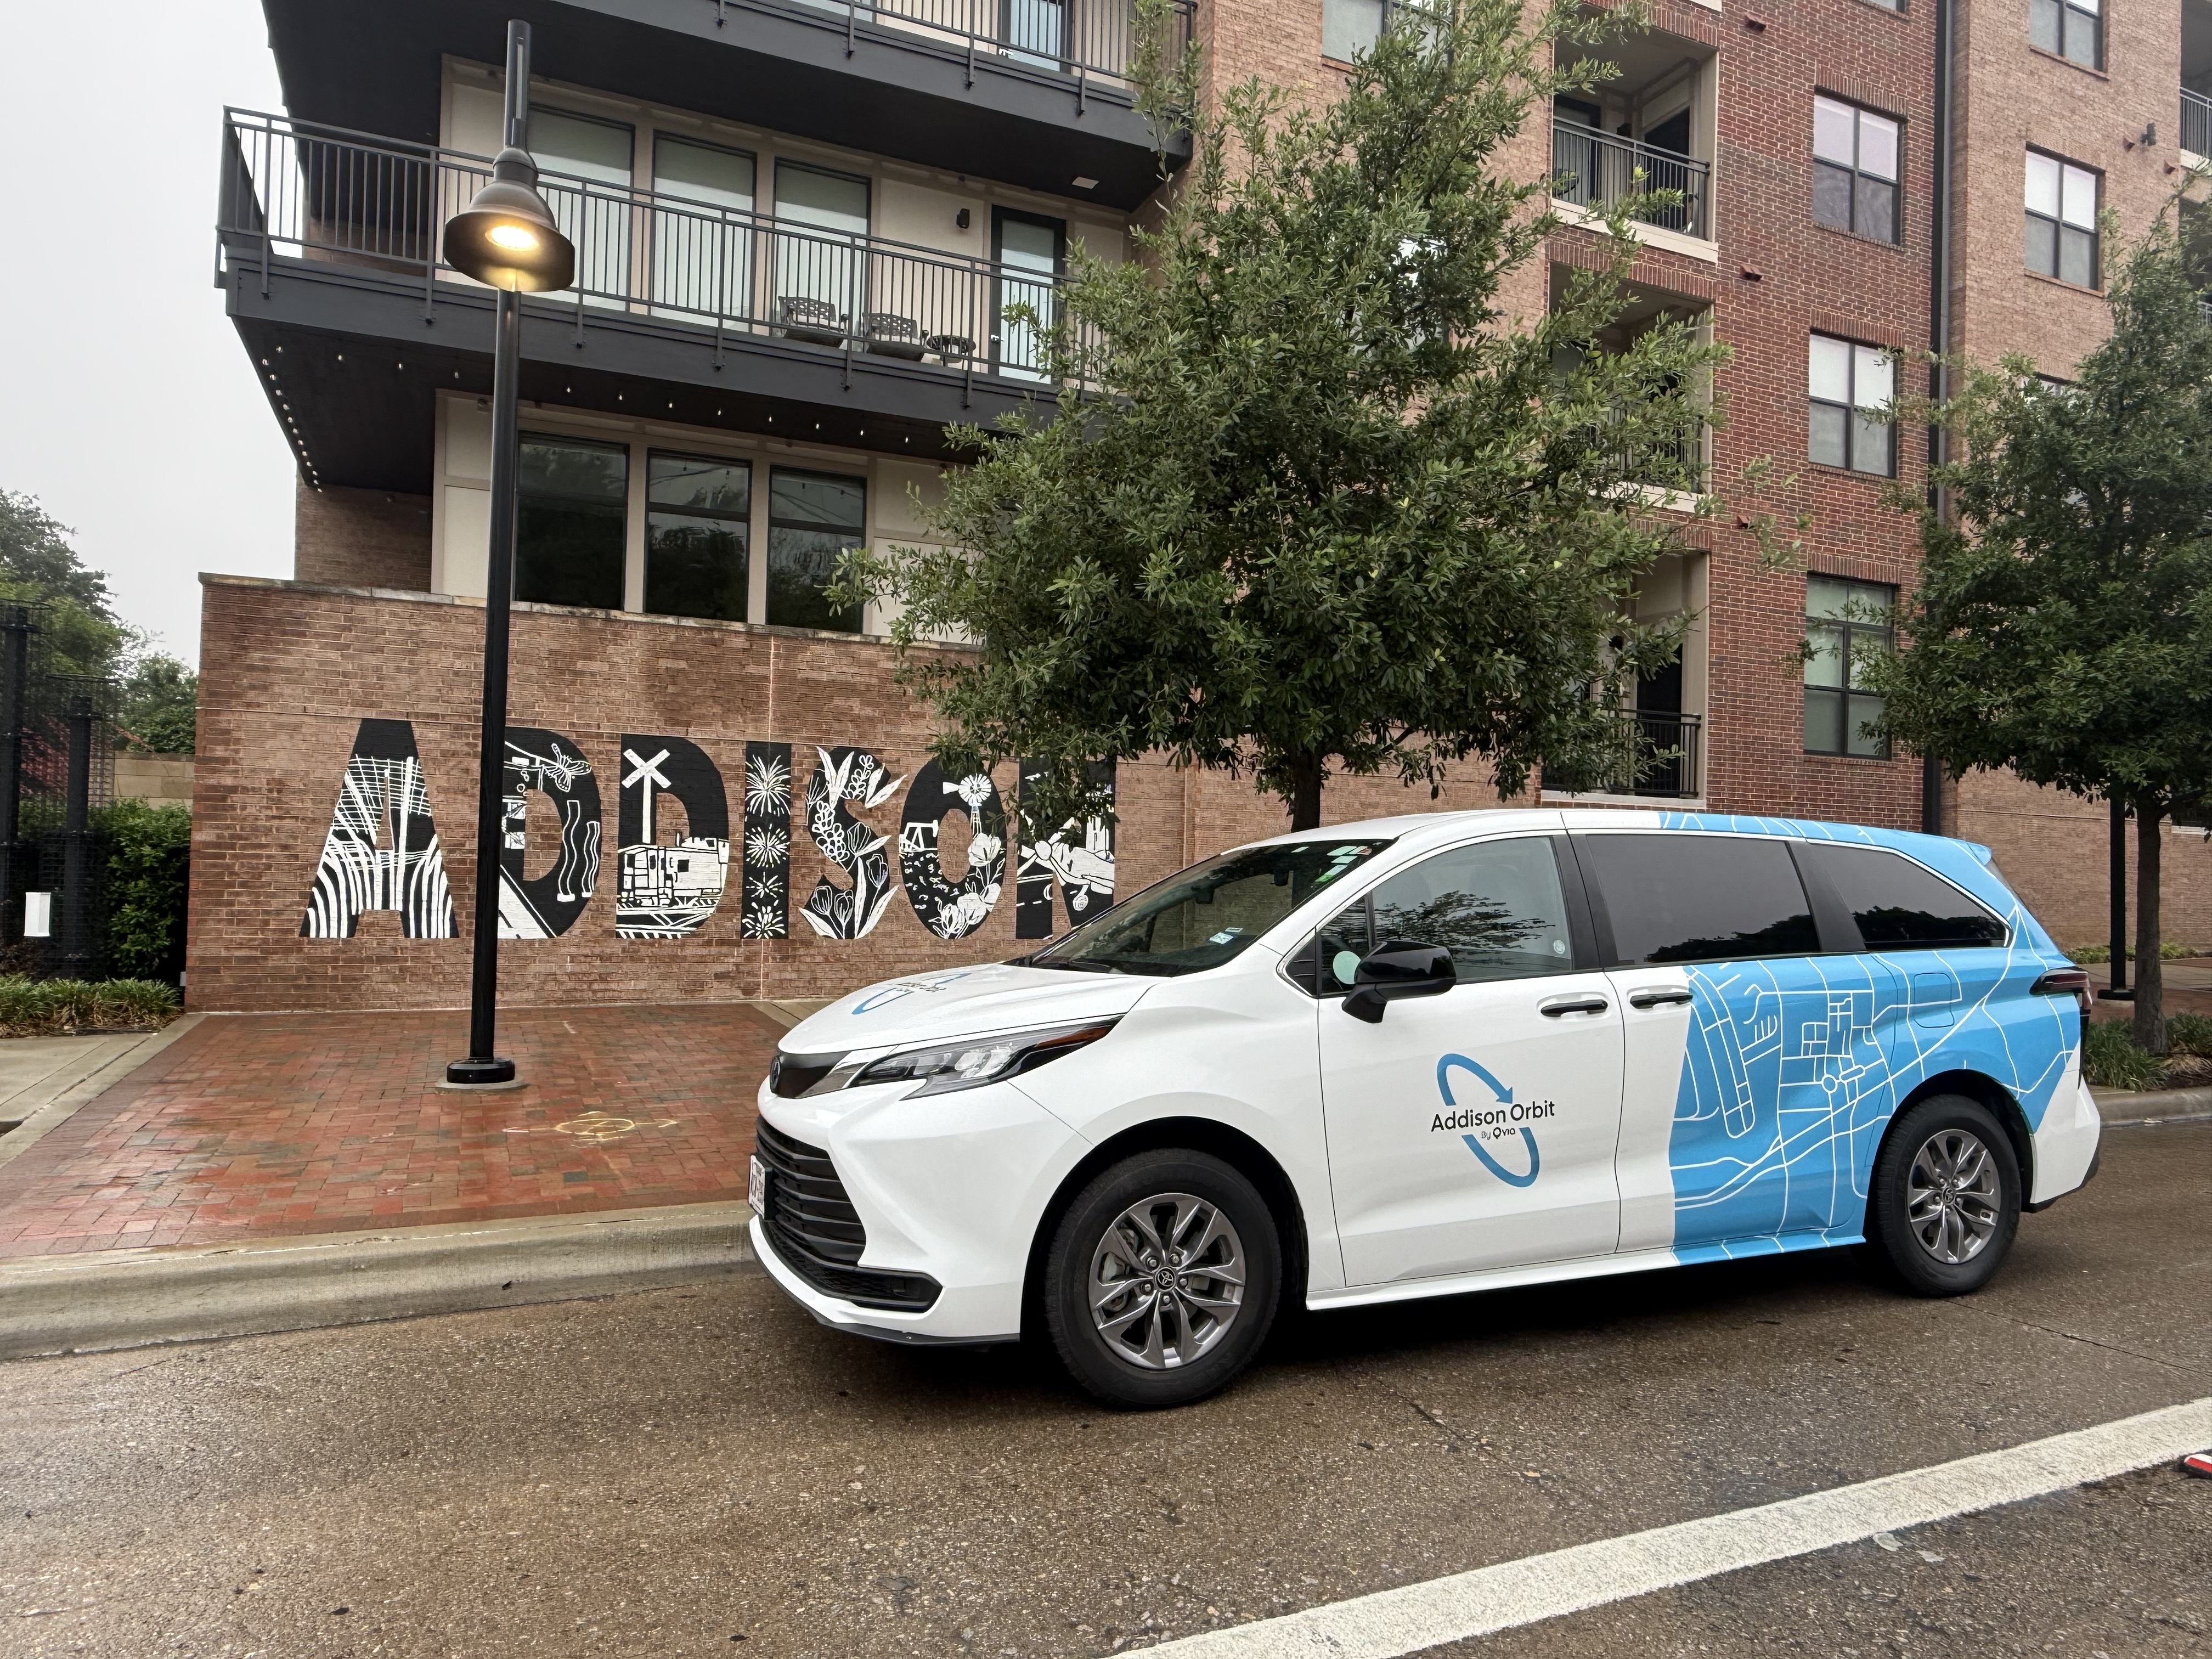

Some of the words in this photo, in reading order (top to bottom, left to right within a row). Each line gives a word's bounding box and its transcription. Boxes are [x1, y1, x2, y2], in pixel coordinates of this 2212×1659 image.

[299, 718, 1116, 940] ADDISON
[1431, 1109, 1506, 1131] Addison
[1510, 1100, 1555, 1121] Orbit
[1481, 1131, 1491, 1140] By
